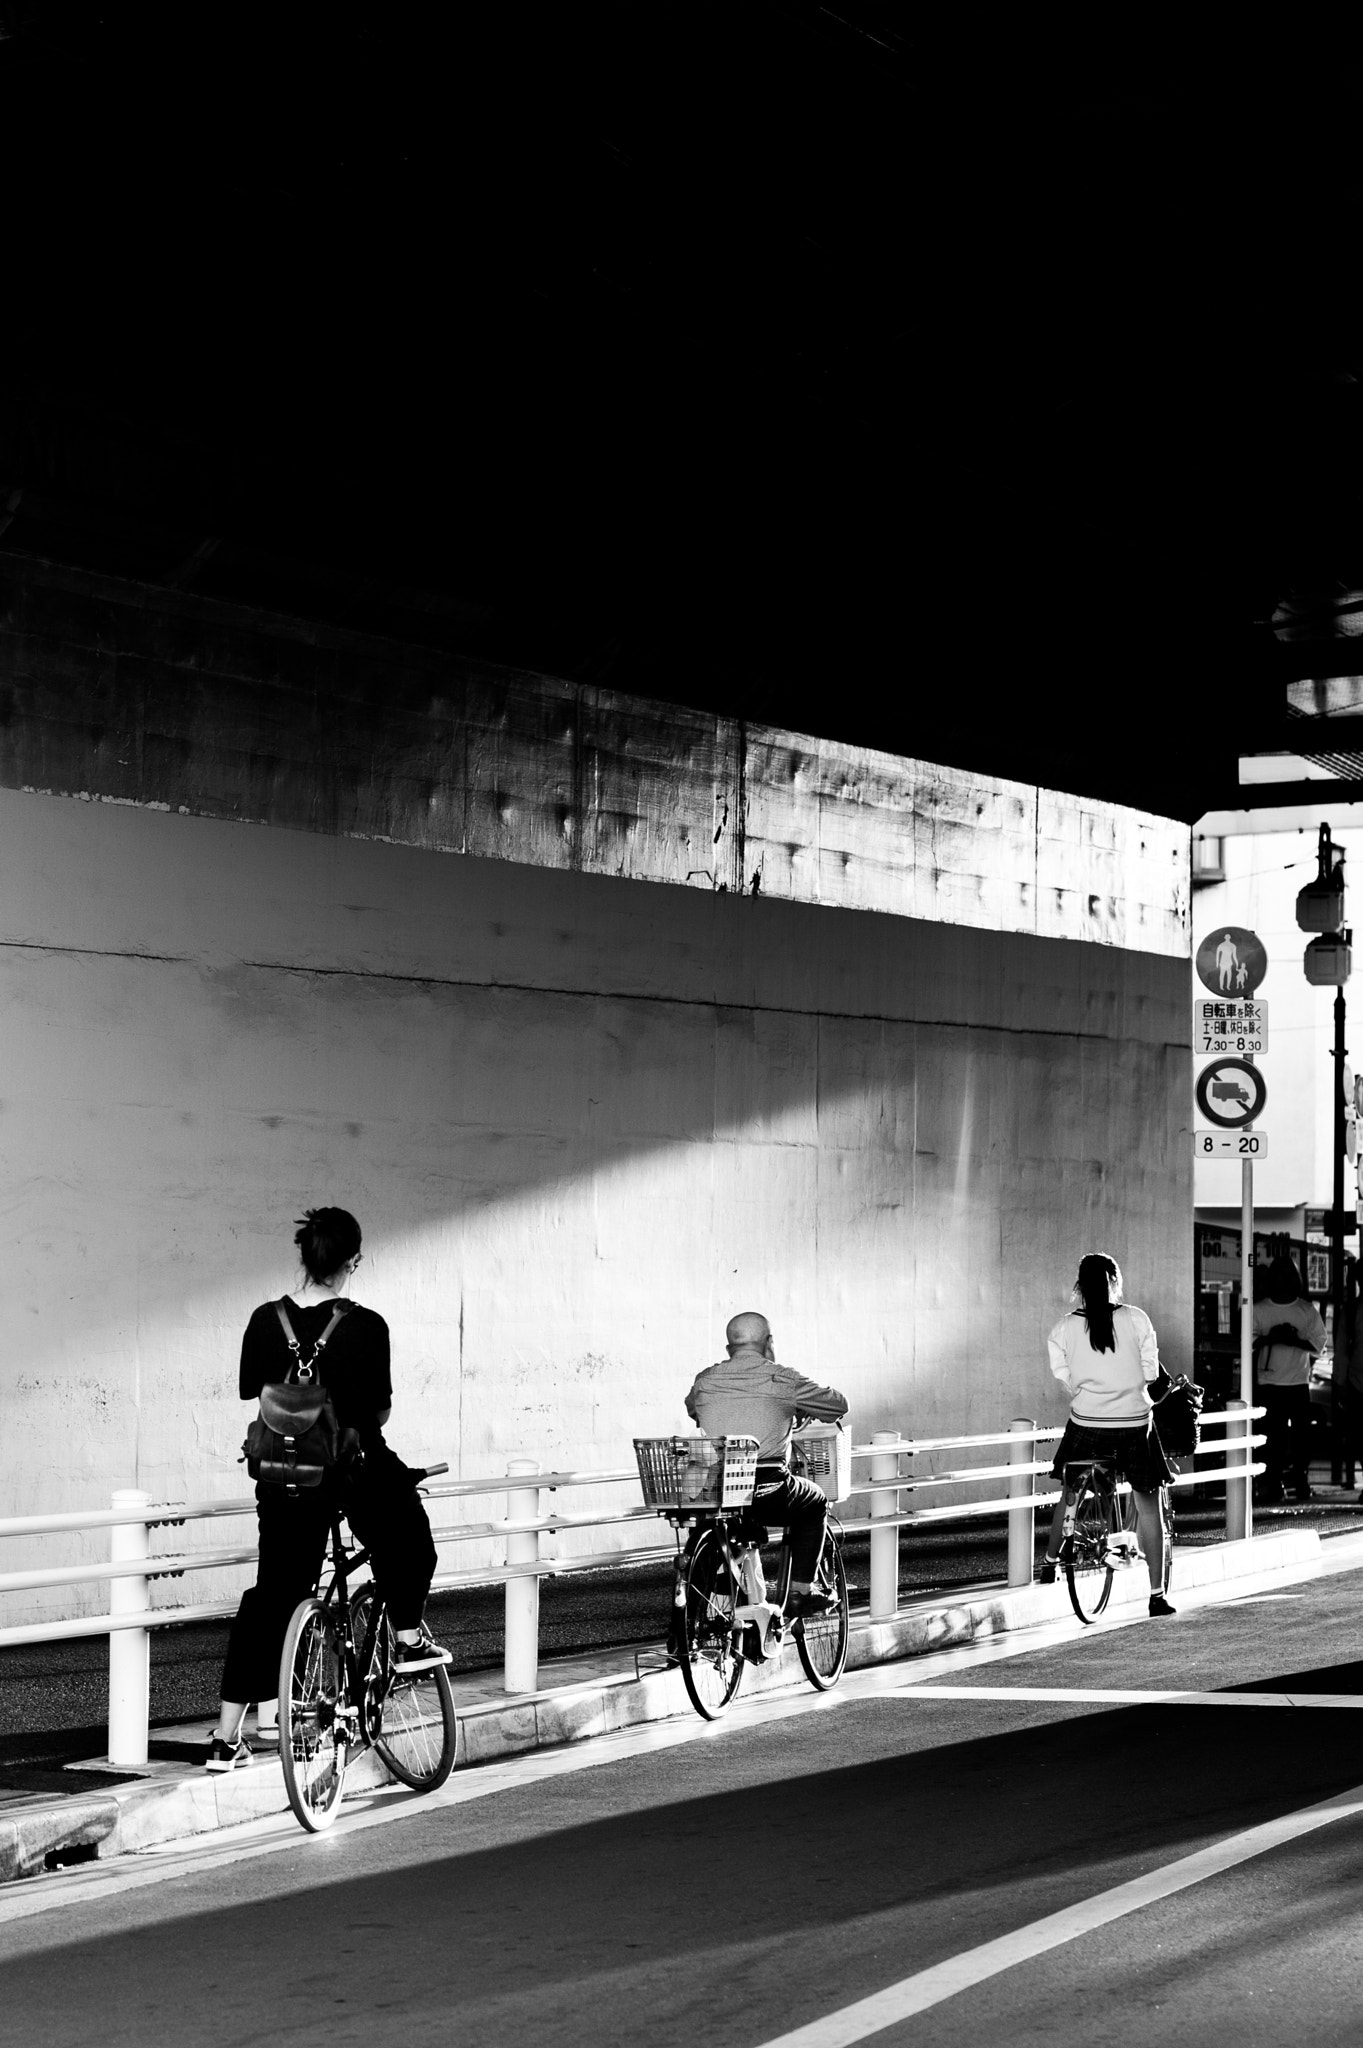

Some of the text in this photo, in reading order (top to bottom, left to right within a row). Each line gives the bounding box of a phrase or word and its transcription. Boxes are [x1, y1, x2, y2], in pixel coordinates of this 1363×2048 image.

[1203, 1002, 1261, 1018] 自転車を除く
